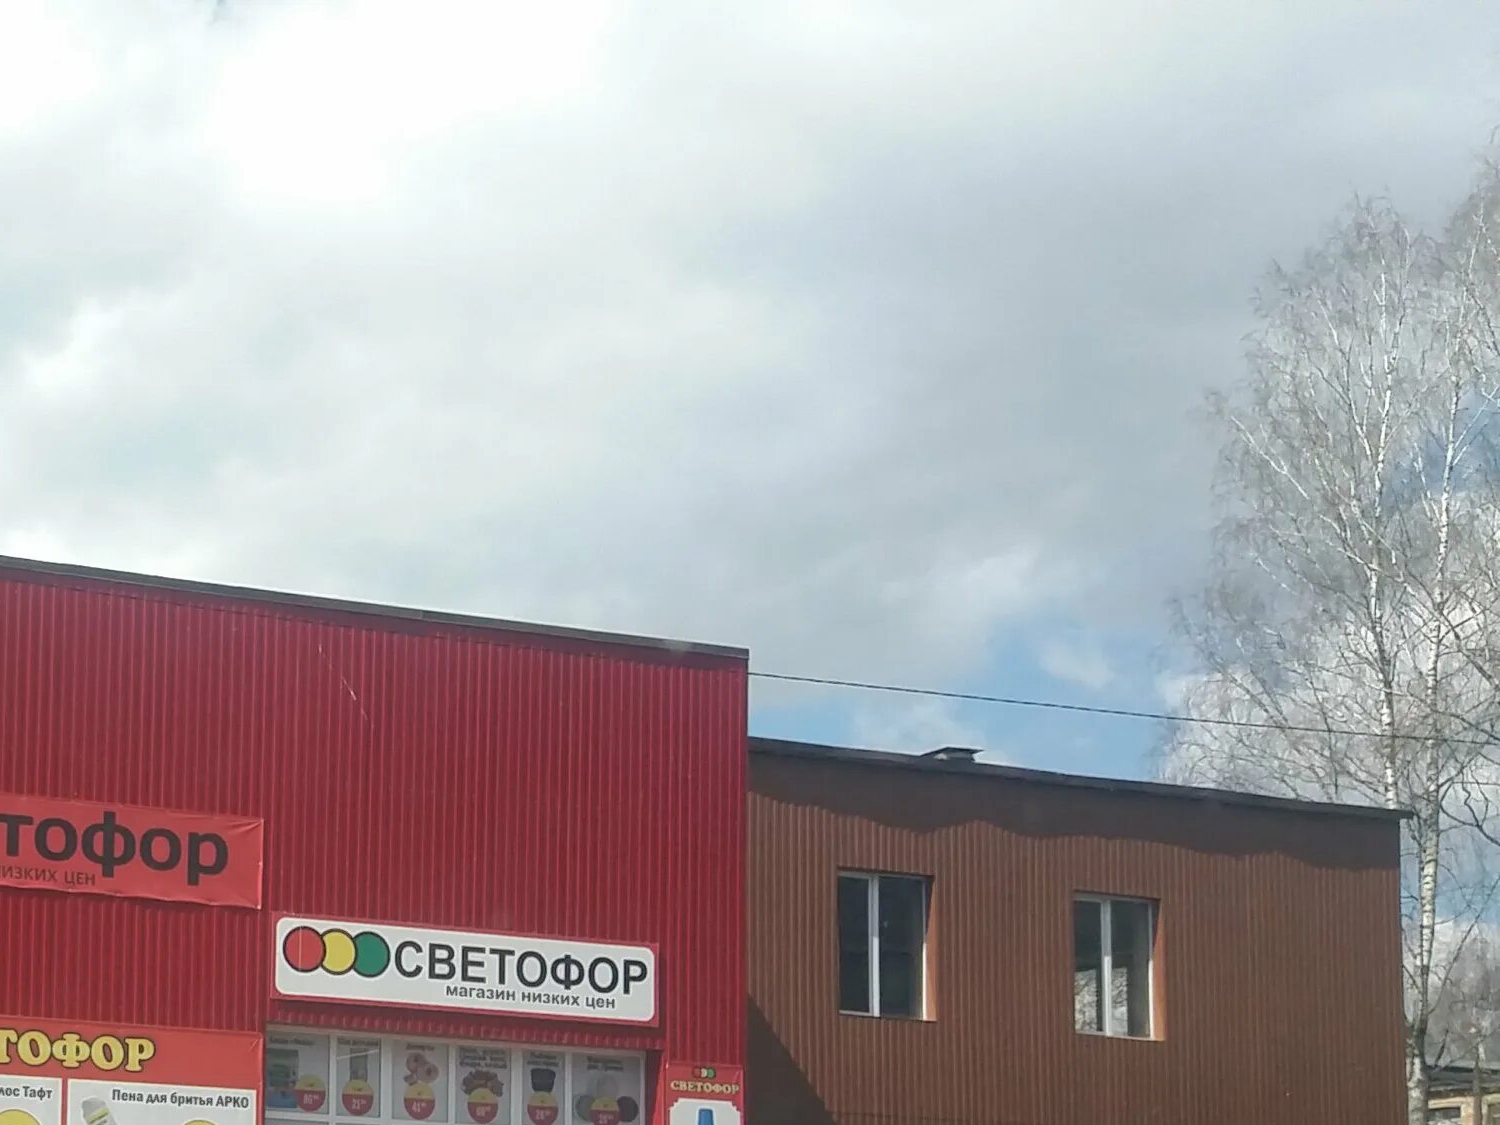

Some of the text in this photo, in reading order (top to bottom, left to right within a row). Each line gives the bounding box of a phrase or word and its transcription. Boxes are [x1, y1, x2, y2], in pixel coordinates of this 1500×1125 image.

[64, 870, 96, 886] ЦЕН
[394, 940, 648, 996] СВЕТОФОР
[445, 984, 616, 1010] магазин низких цен
[23, 1086, 53, 1100] Тафт
[670, 1080, 741, 1094] СВЕТОФОР
[112, 1089, 250, 1109] Пена для бритья АРКО
